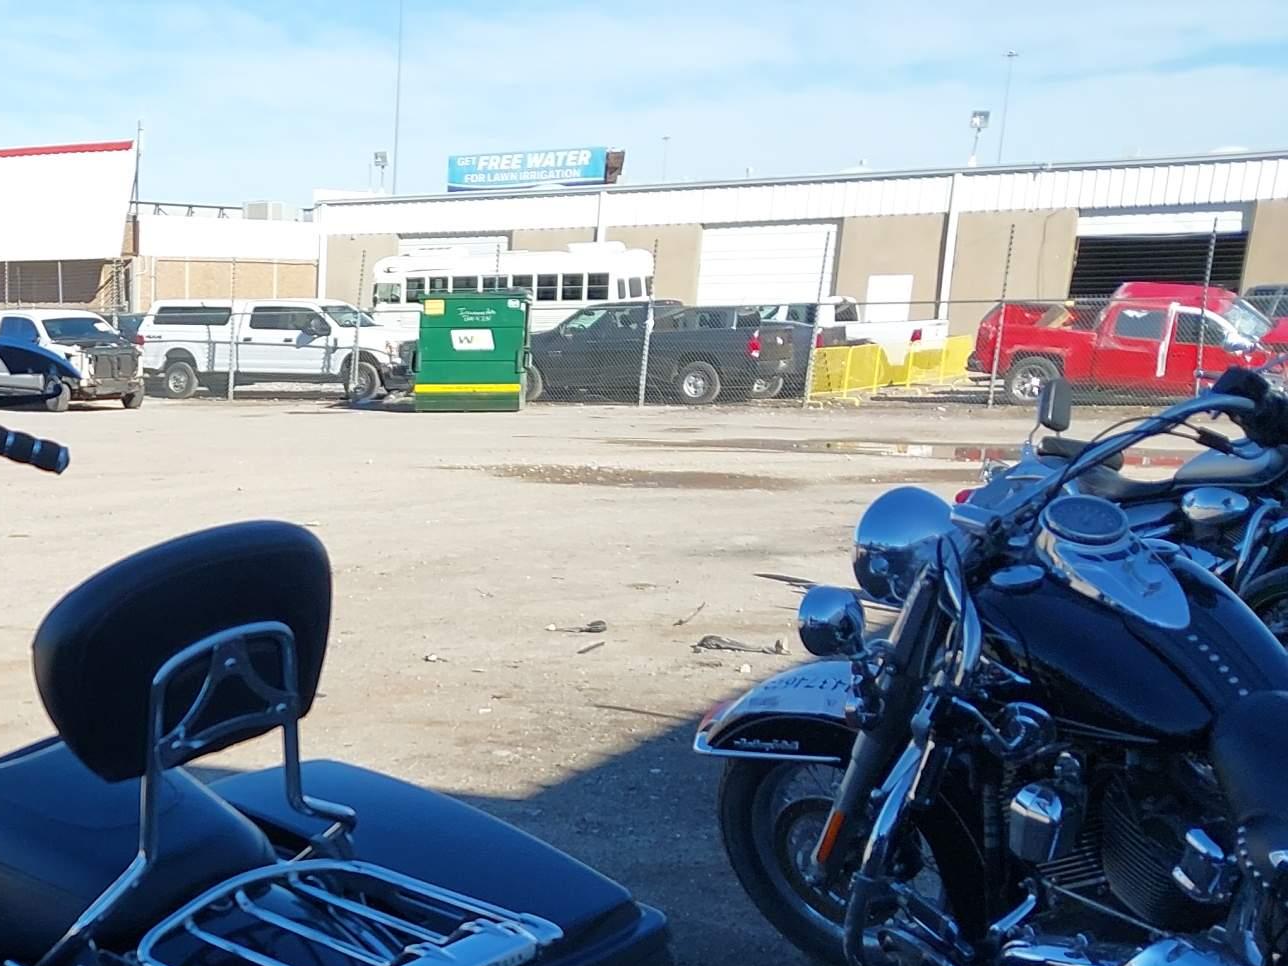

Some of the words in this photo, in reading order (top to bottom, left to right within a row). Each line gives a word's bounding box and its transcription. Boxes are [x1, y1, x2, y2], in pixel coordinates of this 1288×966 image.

[457, 156, 476, 167] GET
[477, 153, 524, 171] FREE
[527, 149, 592, 169] WATER
[464, 173, 486, 183] FOR
[487, 171, 518, 182] LAWN
[519, 168, 581, 181] IRRIGATION
